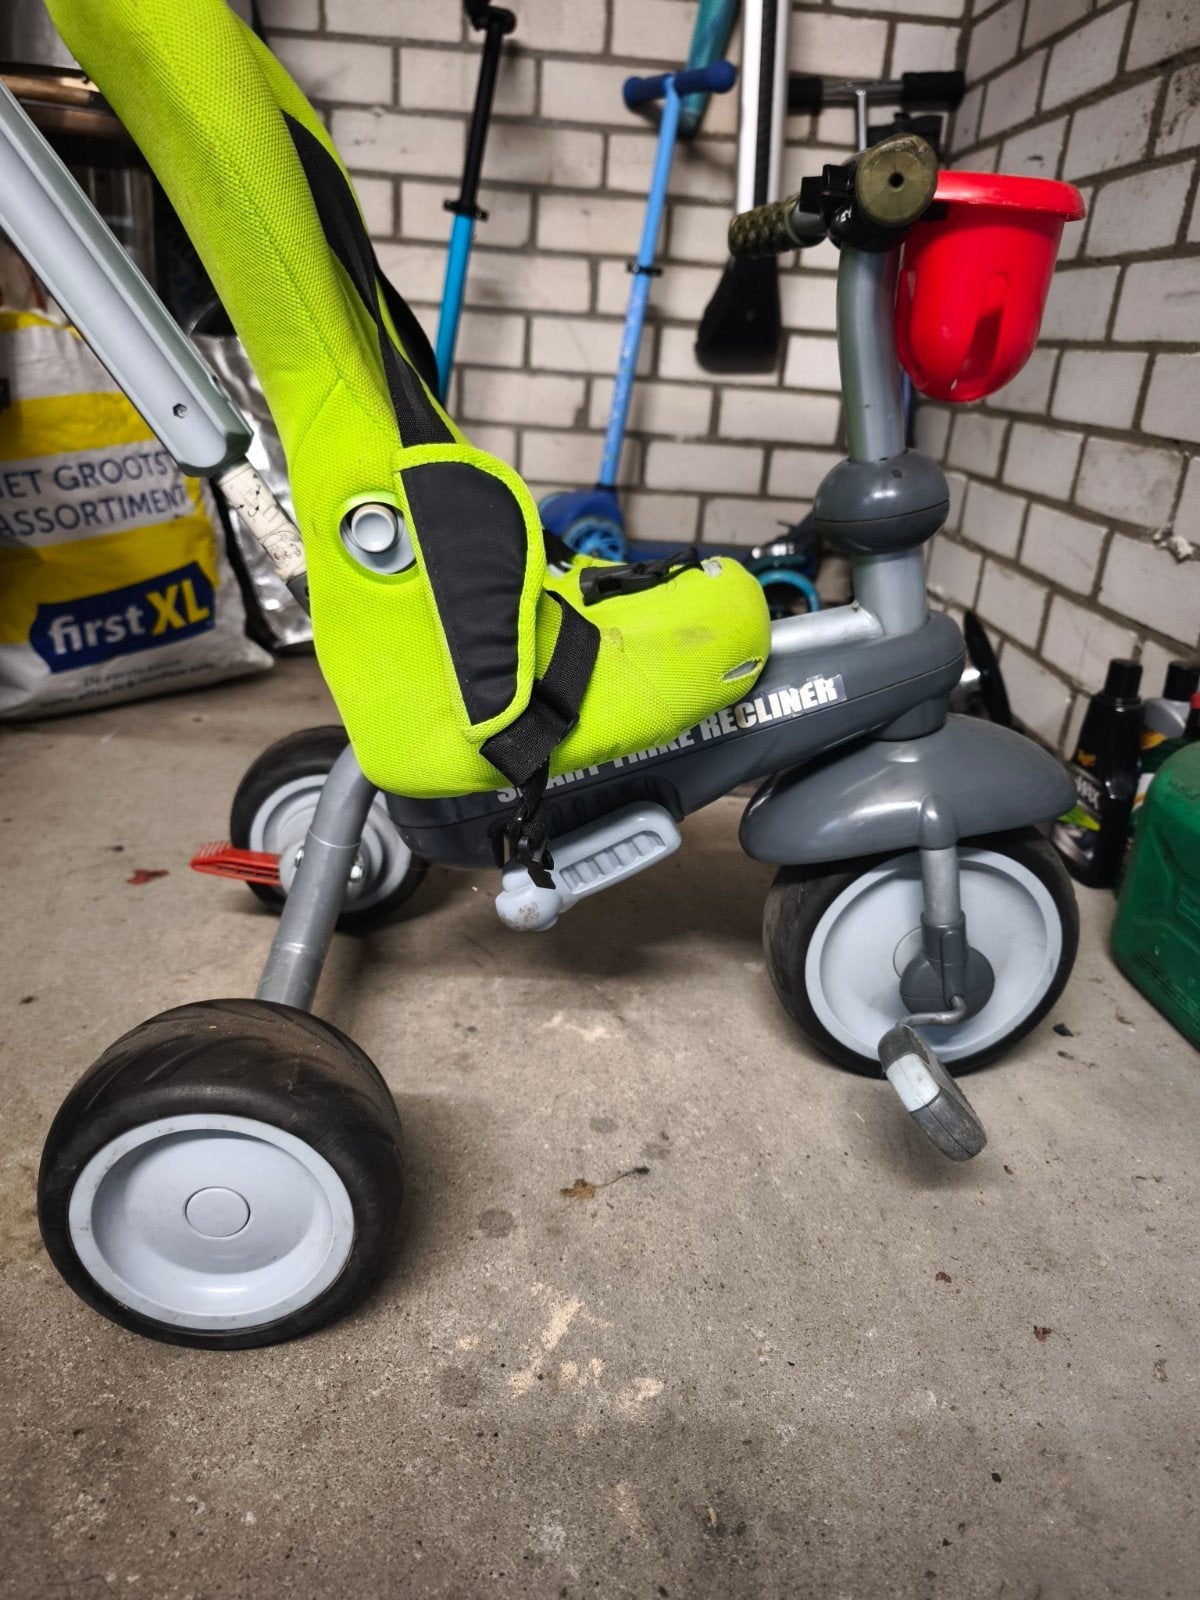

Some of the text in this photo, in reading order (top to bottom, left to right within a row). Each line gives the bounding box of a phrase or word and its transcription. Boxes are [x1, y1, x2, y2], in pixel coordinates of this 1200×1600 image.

[0, 467, 42, 499] ET
[49, 579, 210, 655] first XL
[699, 677, 837, 741] RECLINER
